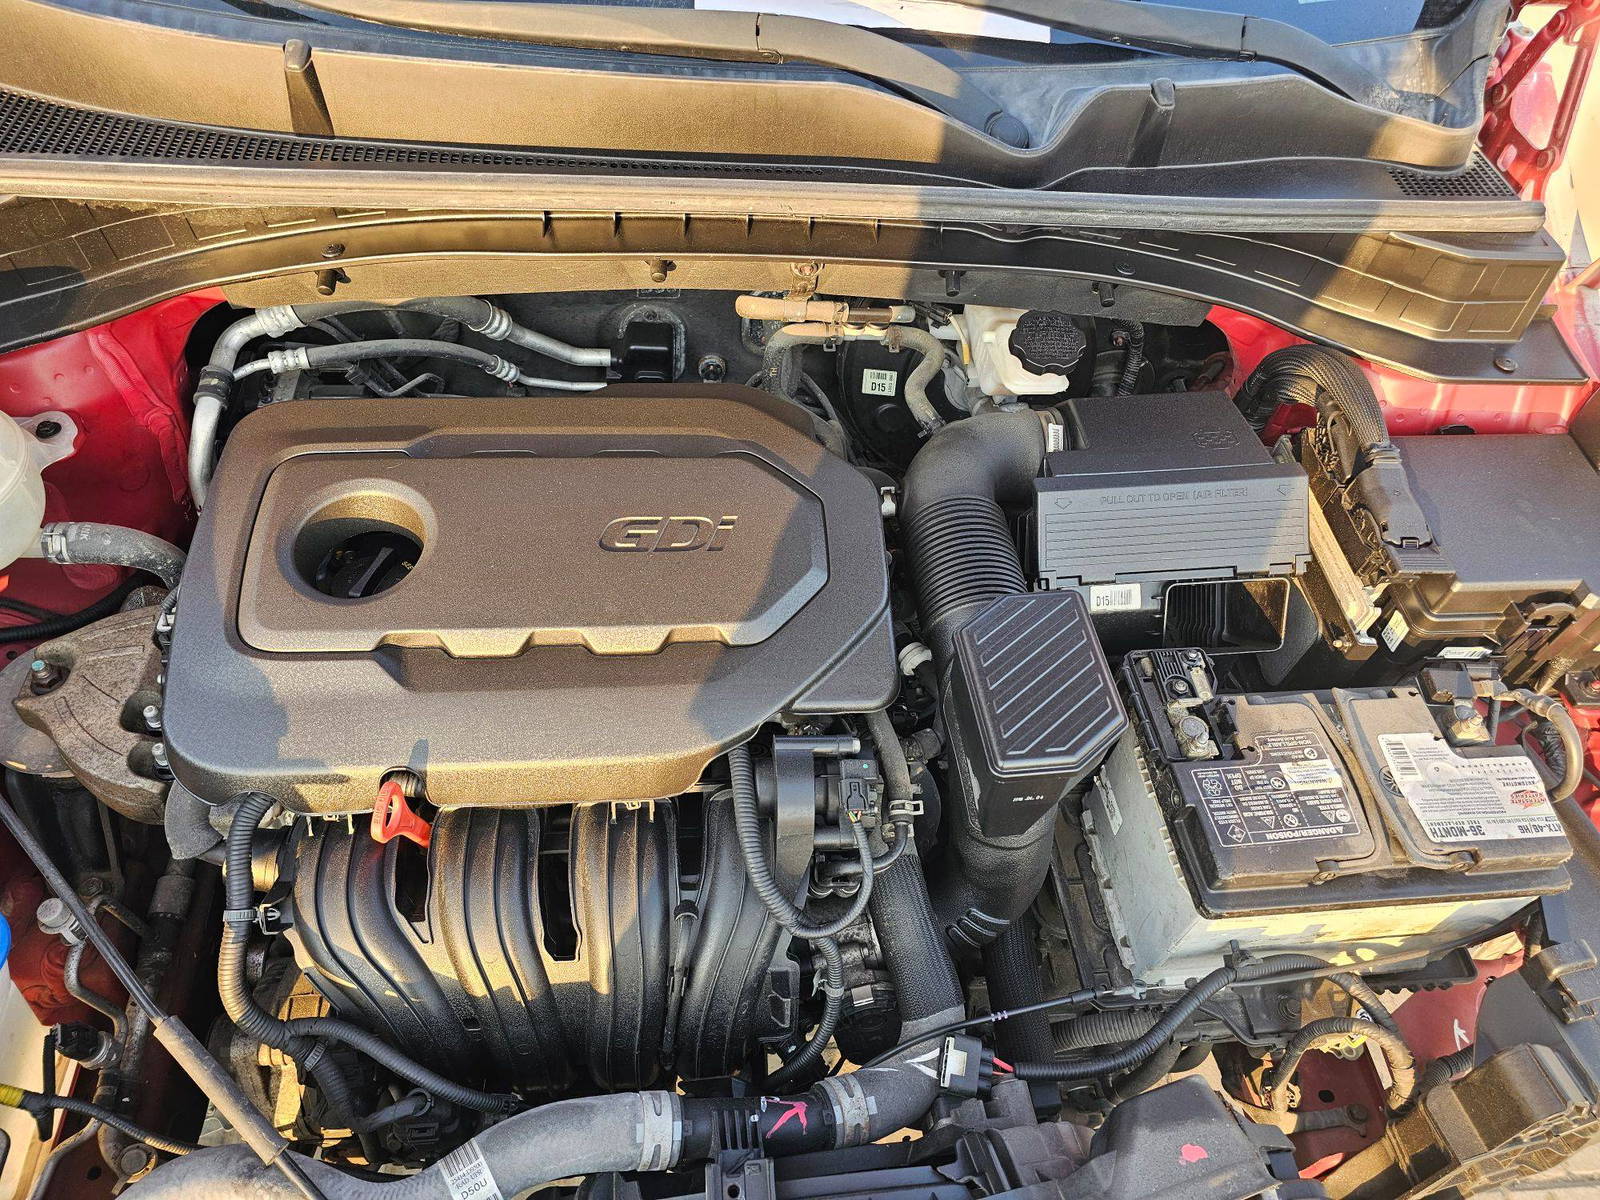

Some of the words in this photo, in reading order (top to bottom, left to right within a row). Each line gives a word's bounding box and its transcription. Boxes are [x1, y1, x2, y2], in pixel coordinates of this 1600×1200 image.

[871, 382, 886, 392] D15
[1100, 496, 1125, 505] PULL
[1127, 494, 1146, 503] OUT
[1096, 595, 1110, 607] D15
[1510, 796, 1547, 804] INTERSTATE
[1429, 824, 1485, 838] 36-MONTH
[461, 1178, 488, 1200] D50U
